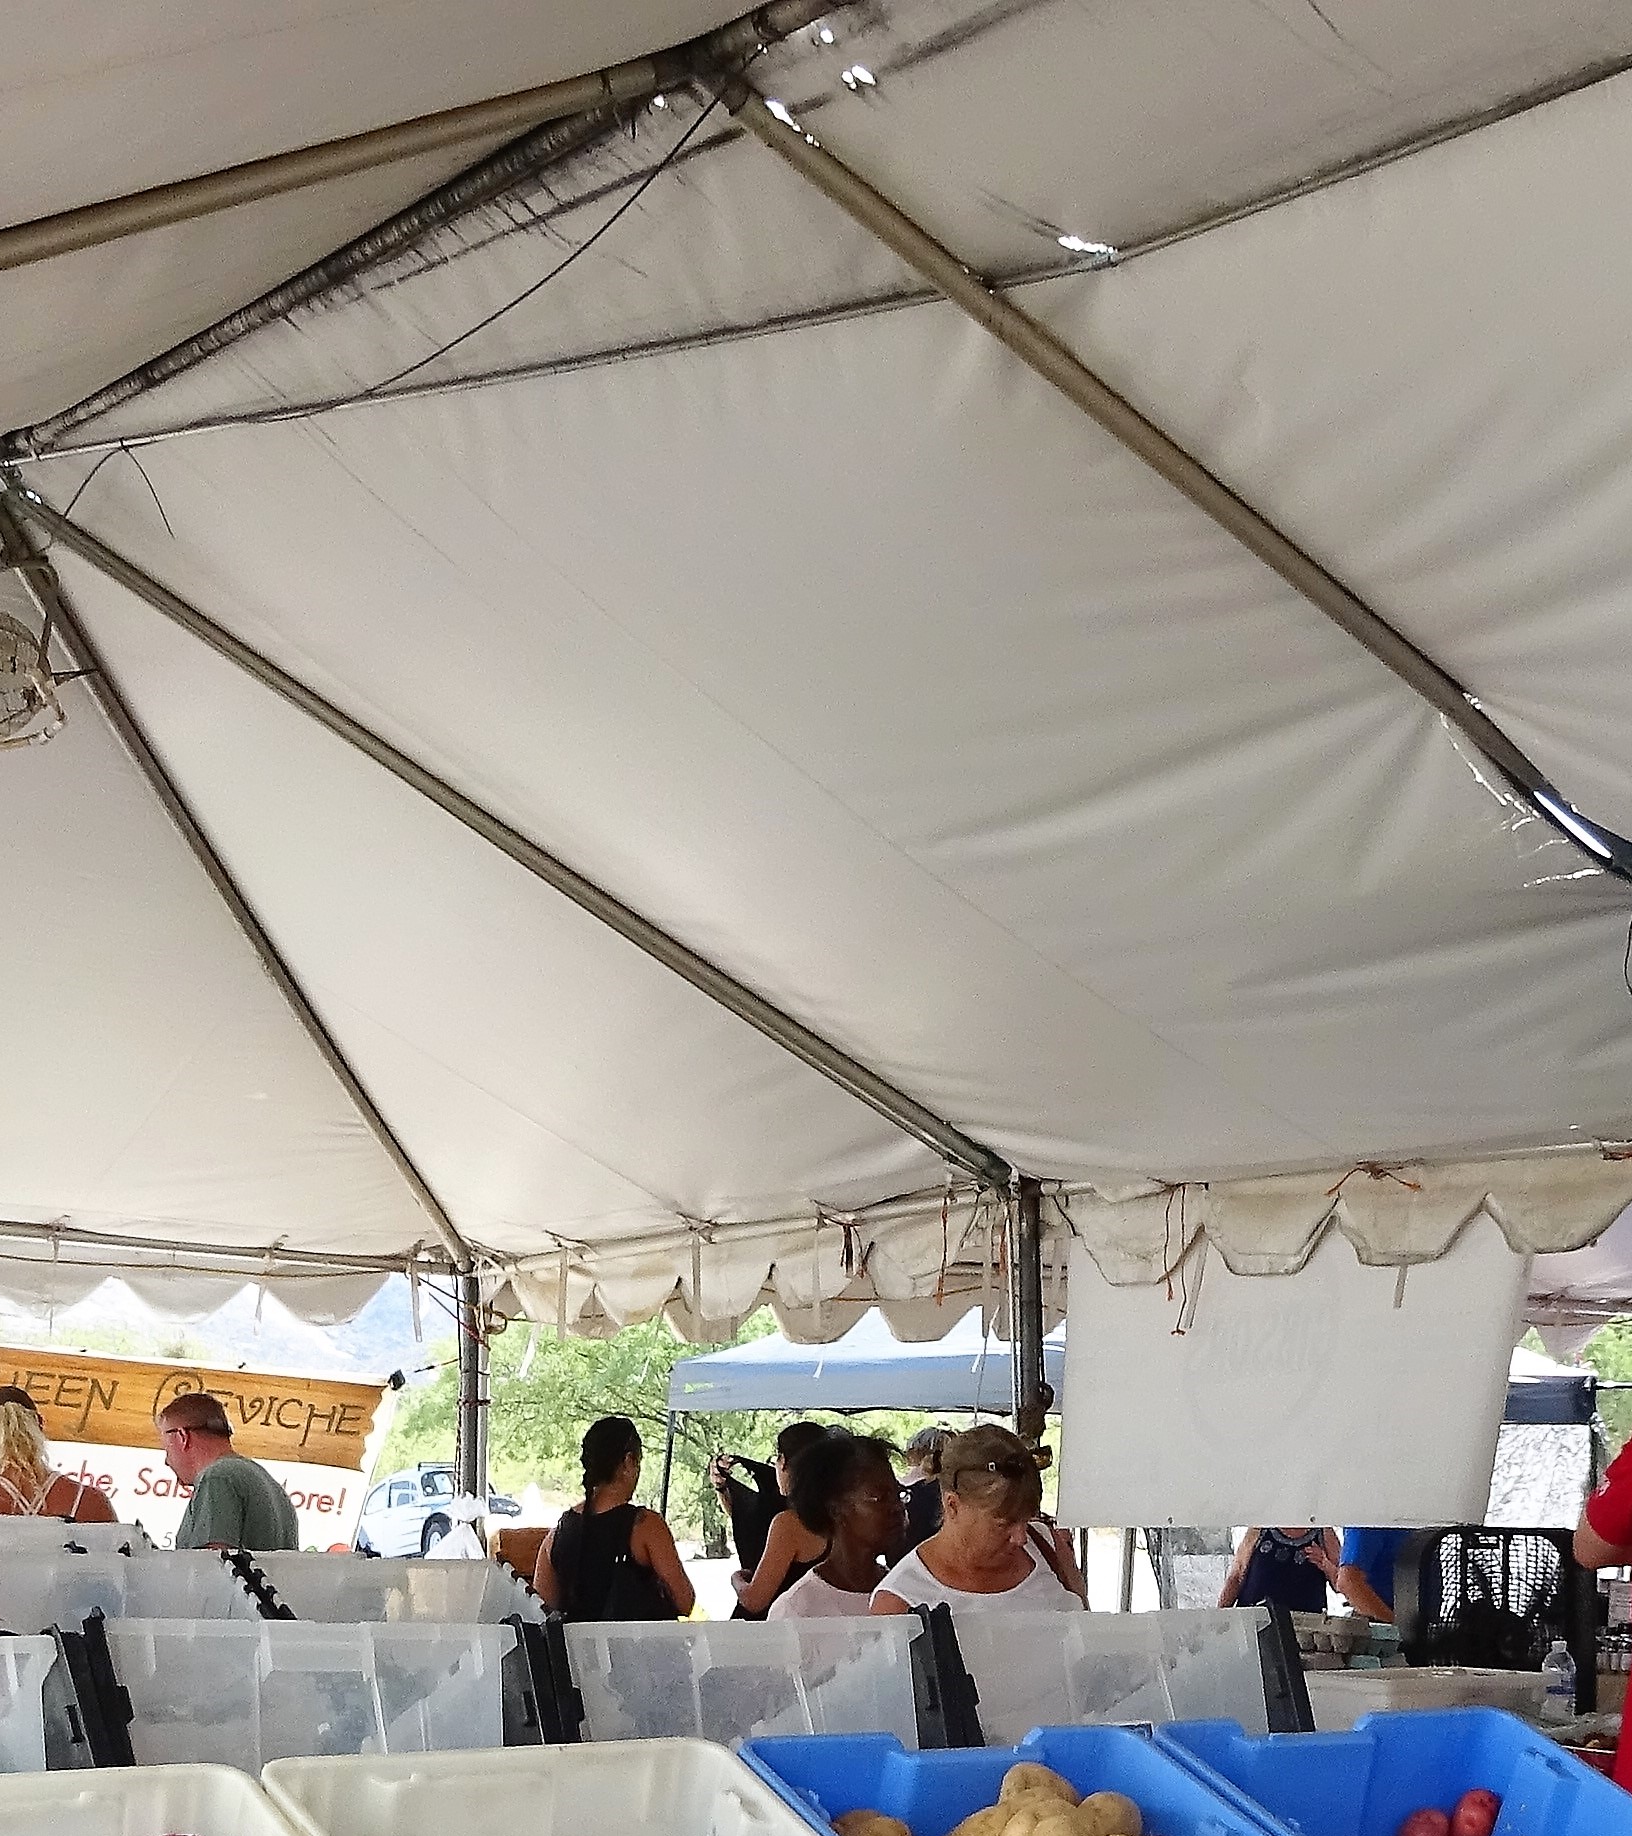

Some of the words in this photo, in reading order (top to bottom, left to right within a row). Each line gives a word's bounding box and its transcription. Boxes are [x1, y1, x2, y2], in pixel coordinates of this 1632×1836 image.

[153, 1370, 366, 1448] CVICHE
[134, 1467, 194, 1498] Sals
[282, 1484, 347, 1516] ore!
